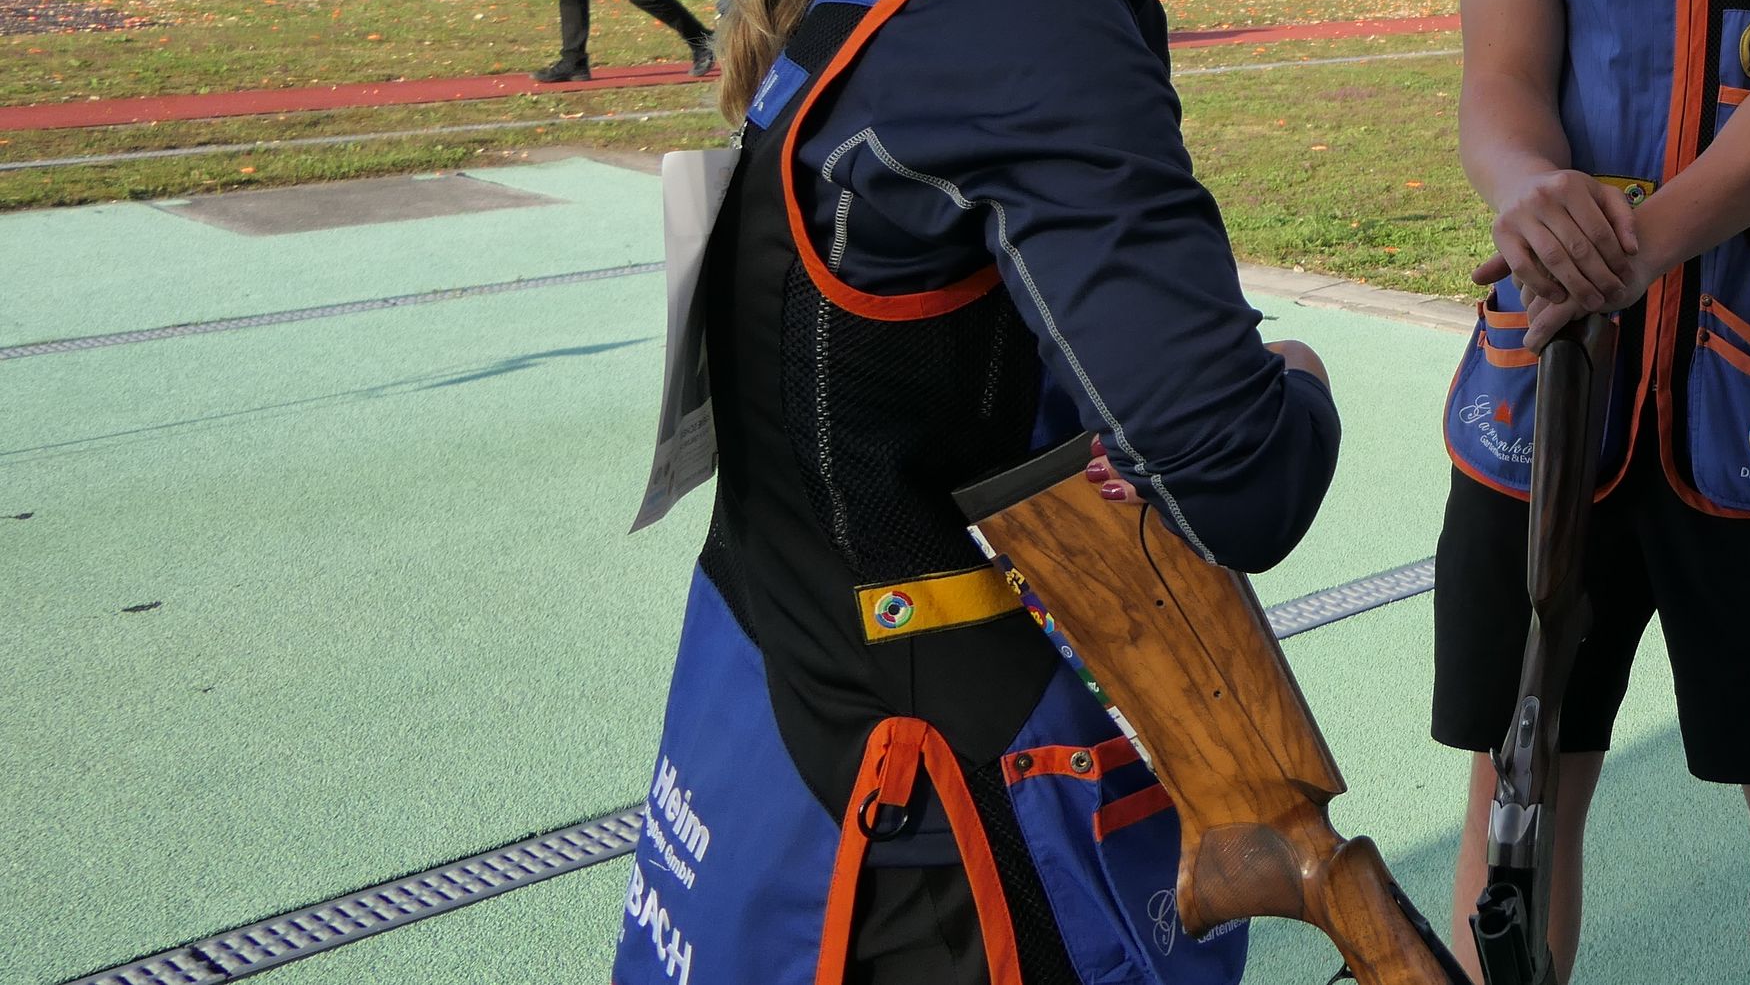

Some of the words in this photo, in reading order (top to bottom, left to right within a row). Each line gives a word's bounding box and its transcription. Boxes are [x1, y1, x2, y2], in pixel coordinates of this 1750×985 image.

[651, 754, 710, 863] Heim
[664, 843, 696, 891] GmbH
[625, 861, 693, 985] BACH
